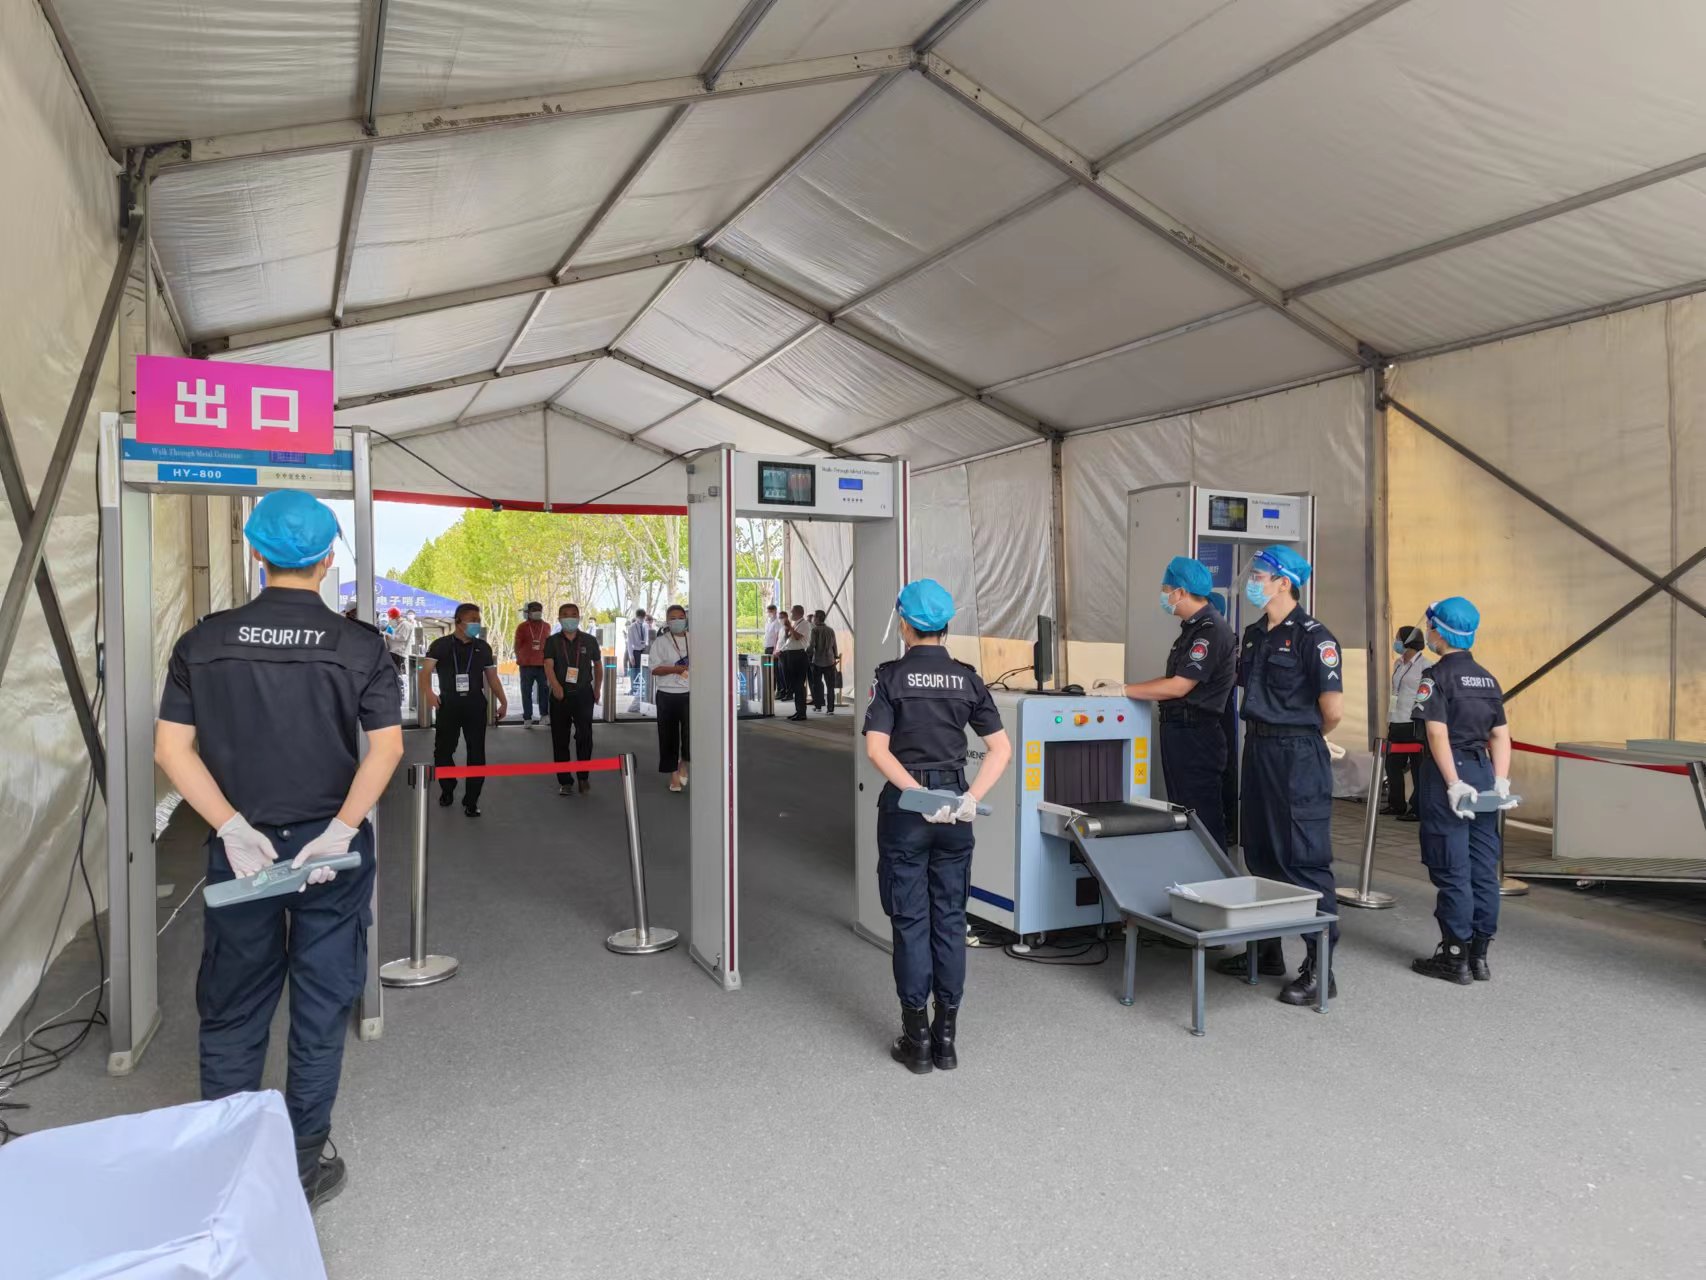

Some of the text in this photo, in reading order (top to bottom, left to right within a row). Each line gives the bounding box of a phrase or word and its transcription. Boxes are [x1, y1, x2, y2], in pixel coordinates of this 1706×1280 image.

[174, 378, 299, 433] 出口
[173, 468, 222, 479] HY-800
[238, 626, 326, 645] SECURITY
[907, 673, 964, 690] SECURITY
[1461, 676, 1495, 688] SECURITY
